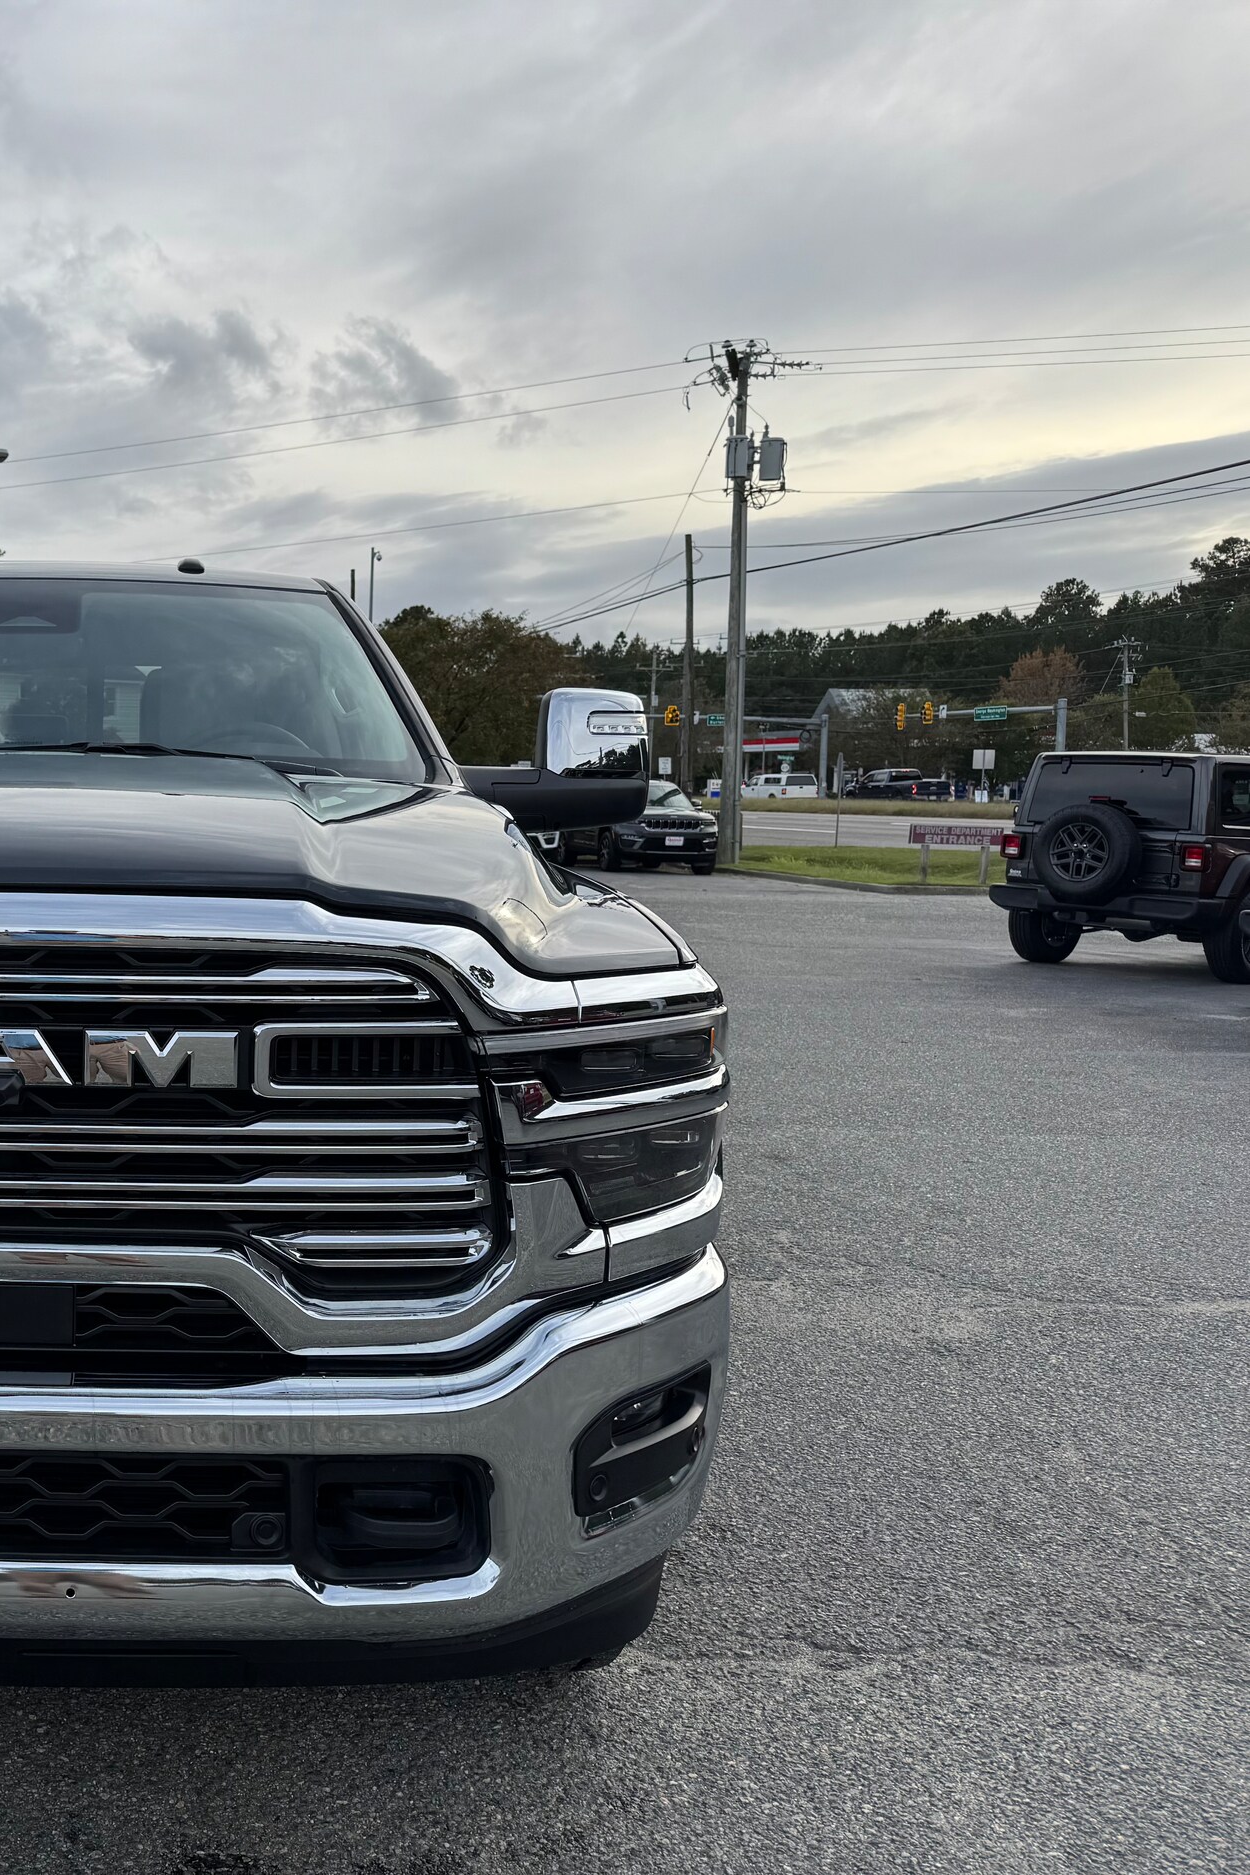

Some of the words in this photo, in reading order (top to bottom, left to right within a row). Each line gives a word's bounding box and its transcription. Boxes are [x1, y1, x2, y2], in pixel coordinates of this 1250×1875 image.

[915, 825, 948, 834] SERVICE
[951, 827, 1002, 836] DEPARTMENT
[924, 834, 991, 844] ENTRANCE
